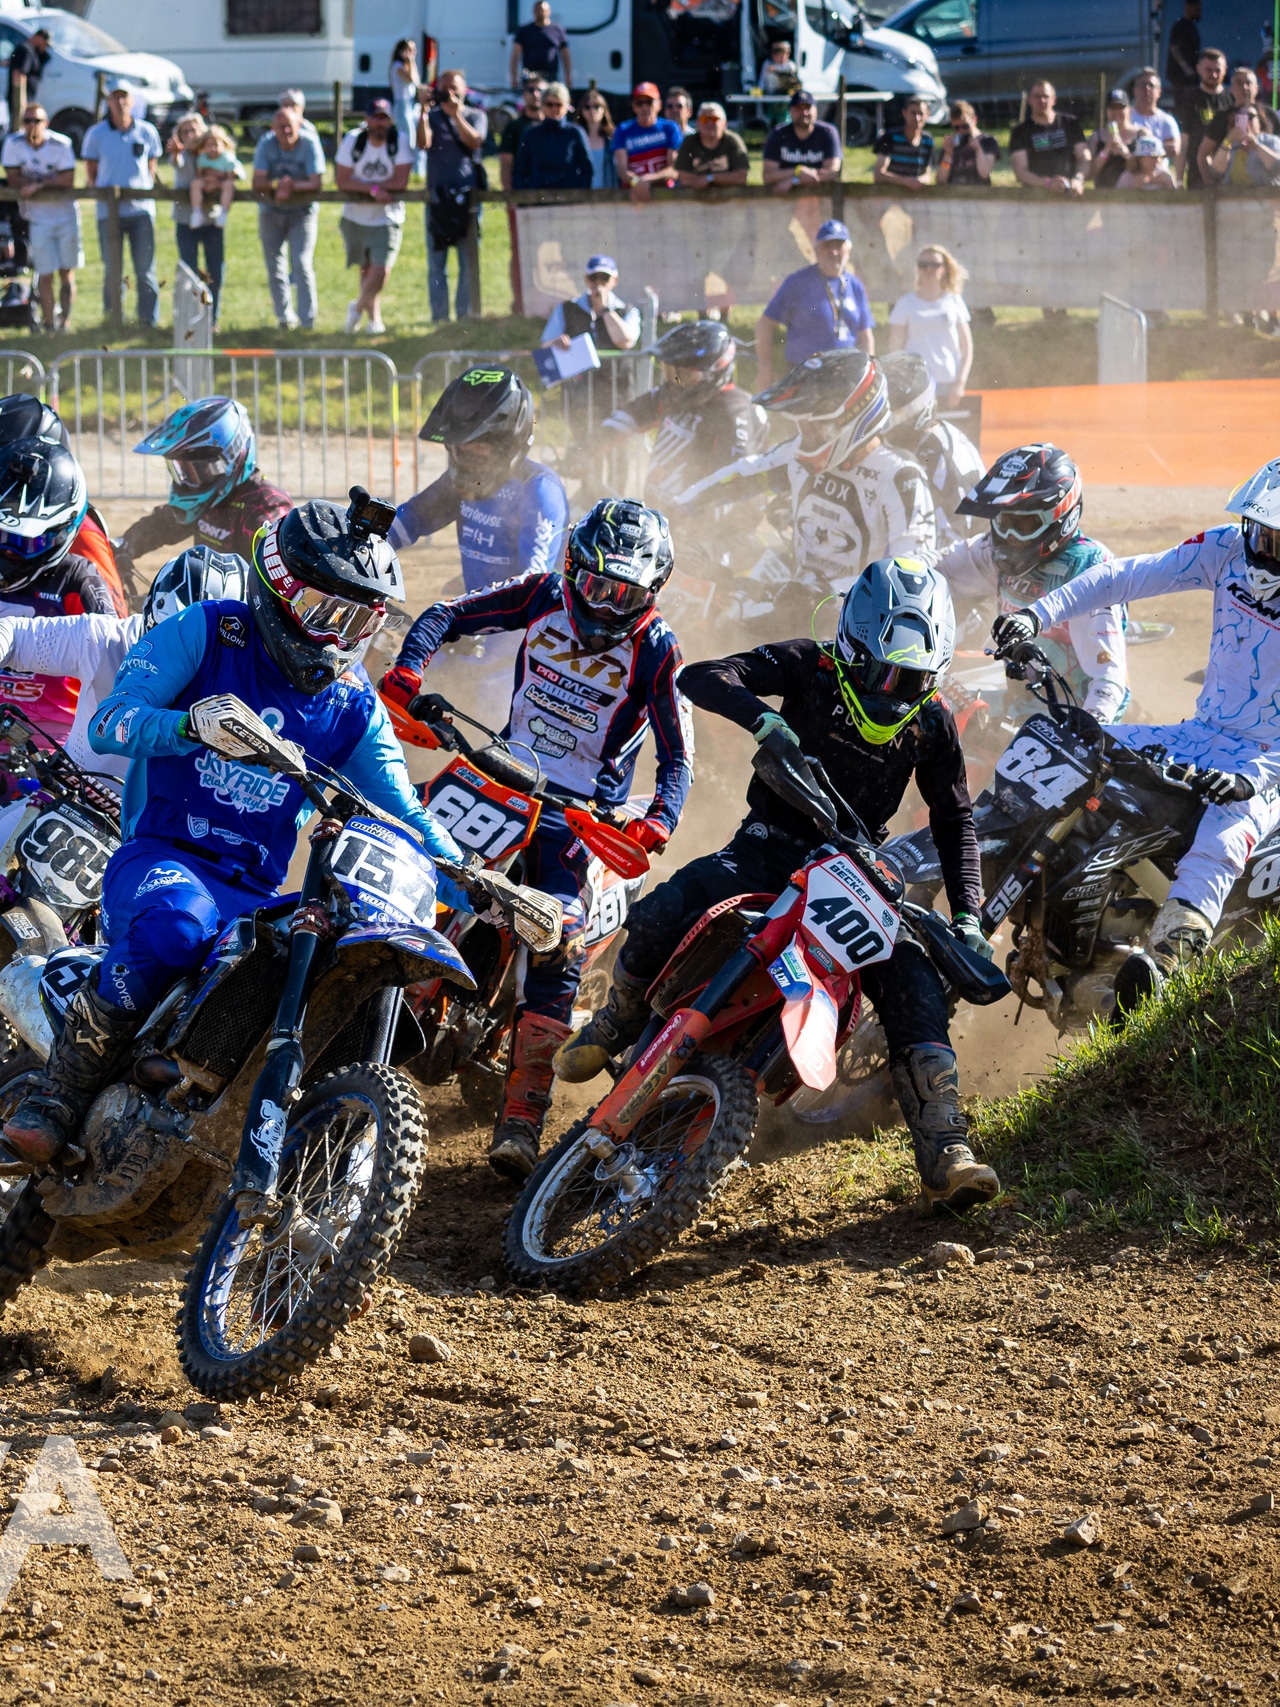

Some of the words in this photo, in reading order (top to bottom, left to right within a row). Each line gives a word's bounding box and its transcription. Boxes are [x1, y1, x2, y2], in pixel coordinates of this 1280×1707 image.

[813, 475, 850, 499] FOX
[528, 626, 628, 689] FXR
[536, 664, 561, 685] PRO
[559, 676, 604, 703] RACE
[221, 717, 271, 753] ACERBIS
[195, 753, 289, 805] JOYRIDE
[995, 736, 1089, 810] 84
[428, 784, 525, 858] 681
[590, 836, 632, 867] POLISPORT
[836, 860, 865, 887] FLORENT
[333, 836, 436, 922] 154
[829, 864, 871, 903] BECKER
[985, 873, 1022, 924] 515
[807, 896, 885, 965] 400
[112, 973, 138, 1012] JOYRID
[773, 970, 793, 990] LTM
[639, 1014, 683, 1072] Polisport
